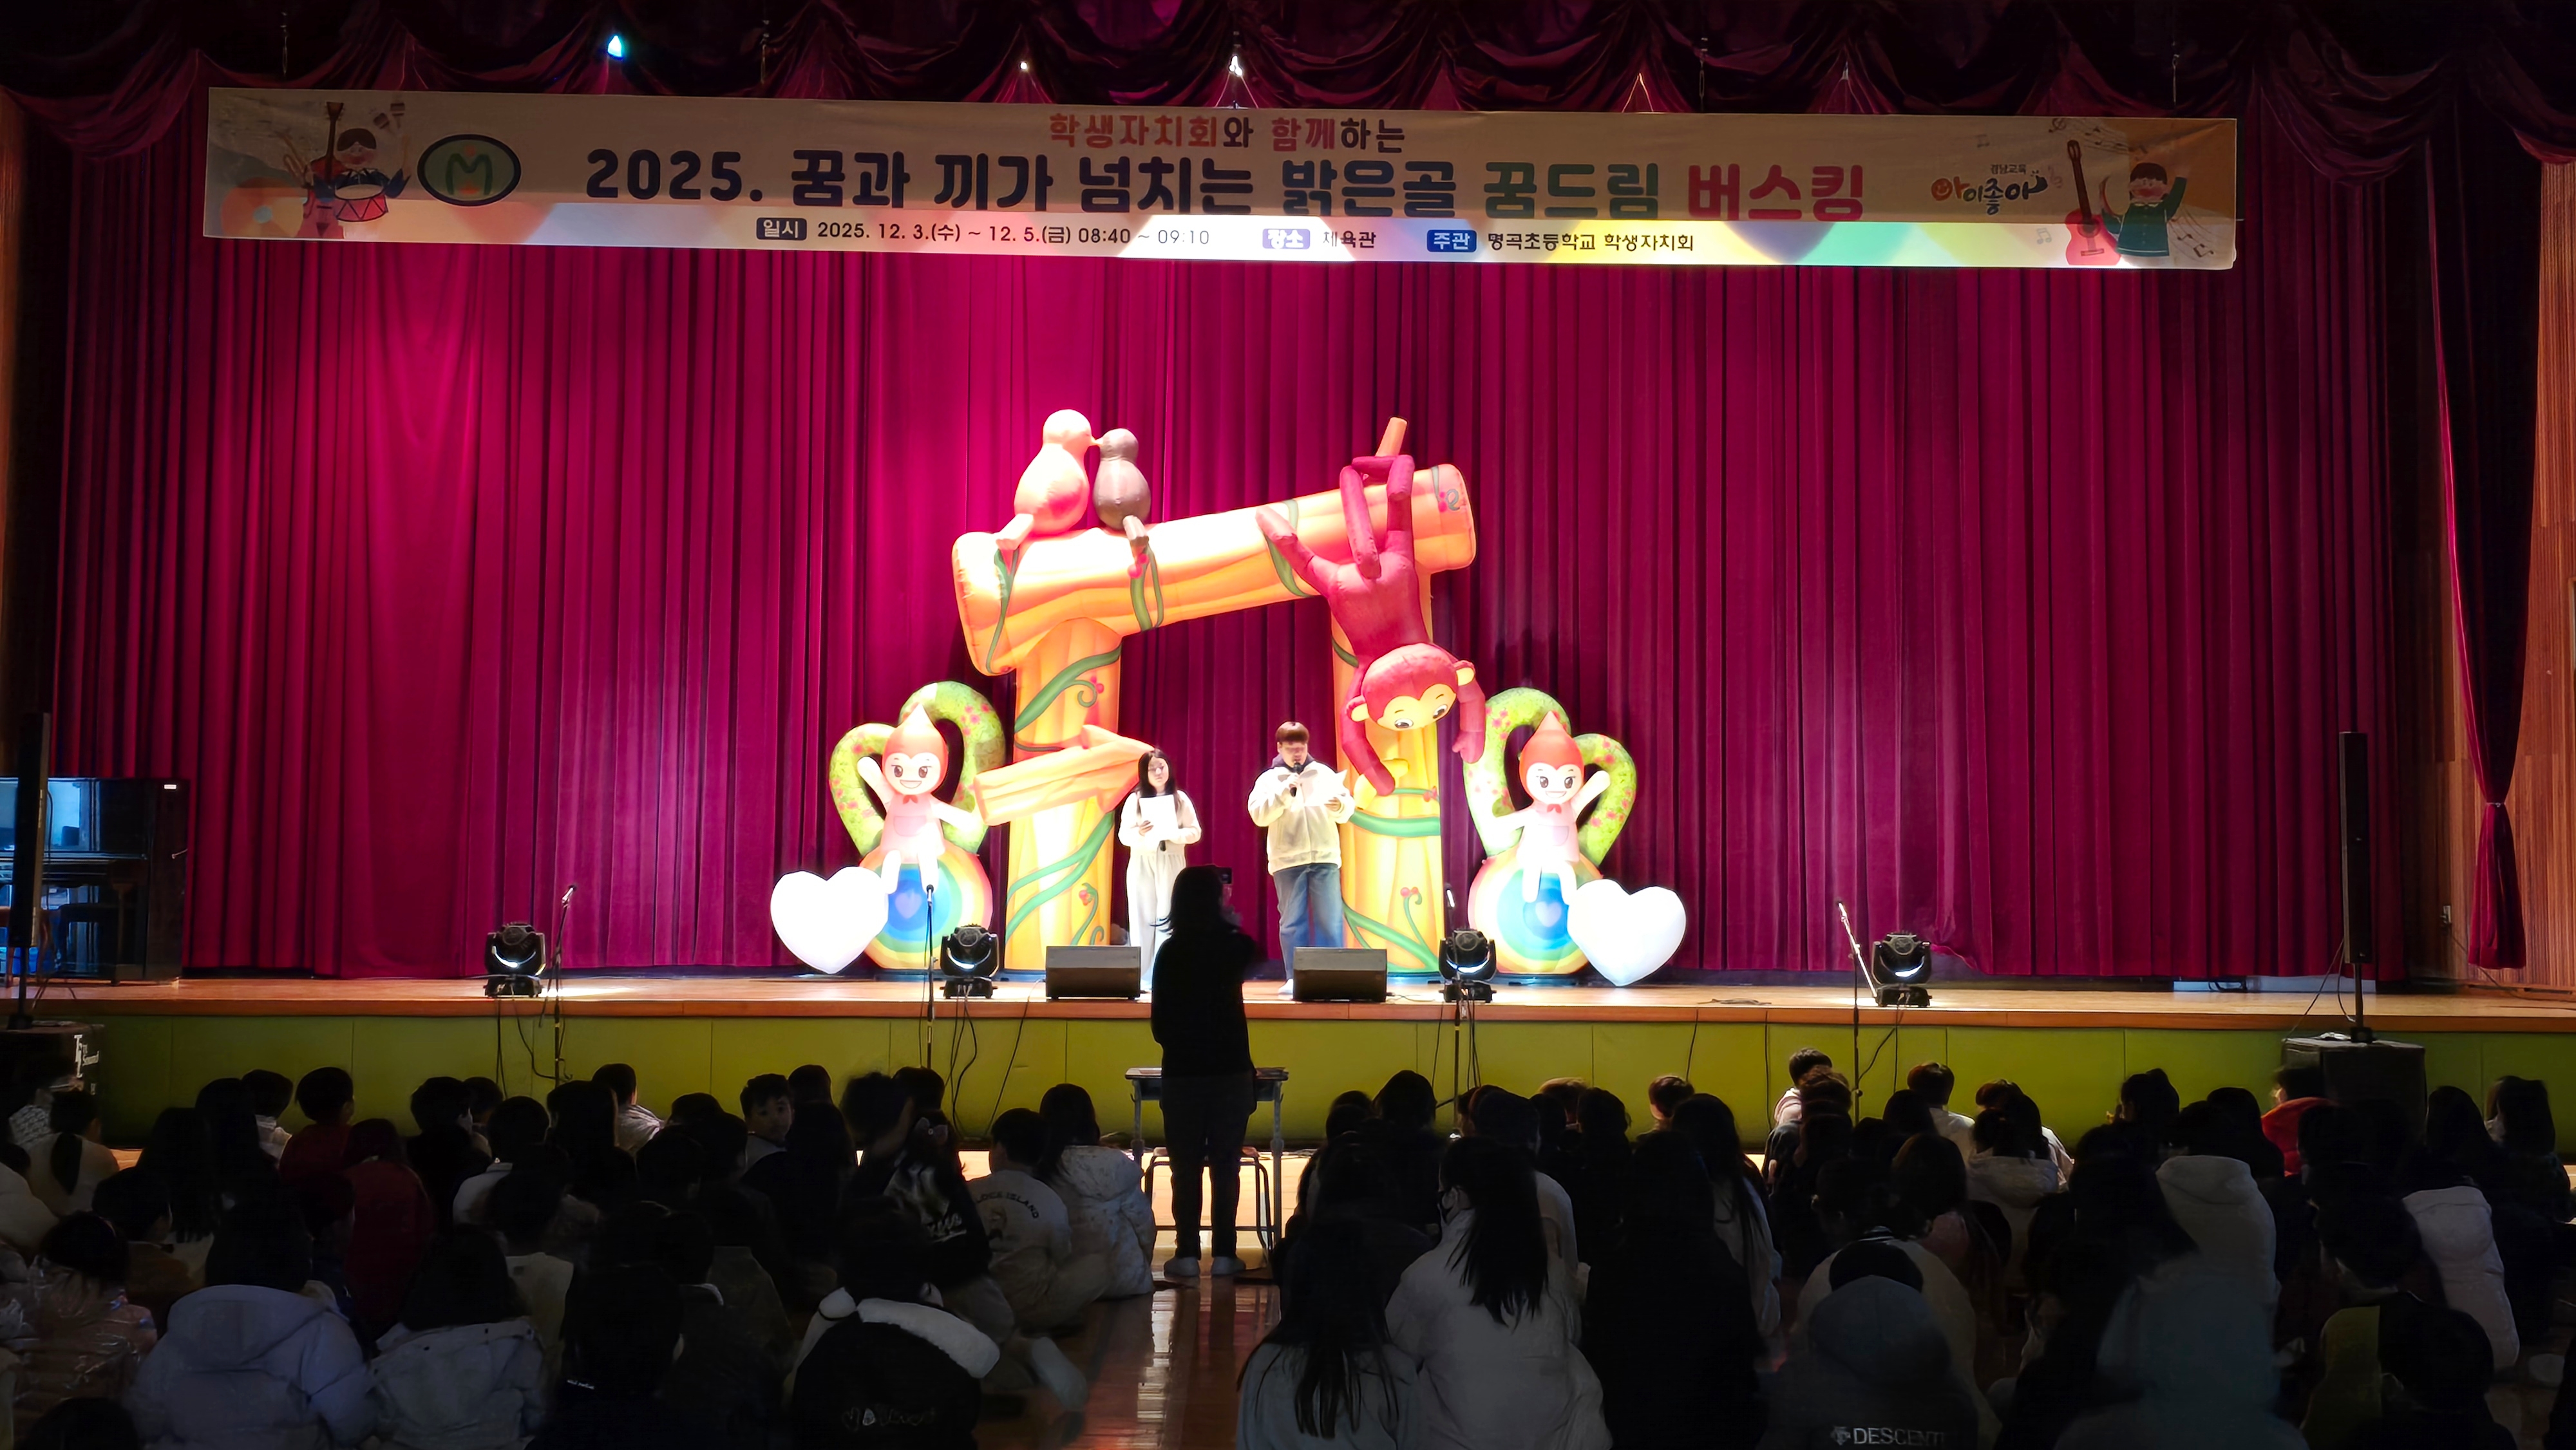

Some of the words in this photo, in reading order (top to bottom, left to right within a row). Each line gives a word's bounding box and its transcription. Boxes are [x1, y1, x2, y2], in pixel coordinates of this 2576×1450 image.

[1049, 113, 1254, 149] 학생자치회와
[1271, 117, 1405, 153] 함께하는
[1991, 164, 2027, 174] 경남교육
[587, 149, 763, 202] 2025.
[791, 149, 911, 209] 꿈과
[934, 153, 1054, 212] 끼가
[1079, 156, 1253, 214] 넘치는
[1282, 159, 1456, 218] 밝은골
[1484, 162, 1660, 220] 꿈드림
[1688, 164, 1864, 221] 버스킹
[1931, 175, 2049, 216] 아이좋아
[763, 218, 799, 238] 일시
[817, 222, 869, 238] 2025.
[878, 223, 905, 239] 12.
[913, 223, 960, 241] 3.(수)
[989, 226, 1016, 241] 12.
[1023, 225, 1071, 245] 5.(금)
[1078, 227, 1131, 243] 08:40
[1158, 229, 1209, 245] 09:10
[1267, 229, 1304, 249] 장소
[1323, 230, 1376, 249] 체육관
[1434, 232, 1470, 250] 주관
[1488, 233, 1596, 251] 명곡초등학교
[1604, 234, 1693, 252] 학생자치회
